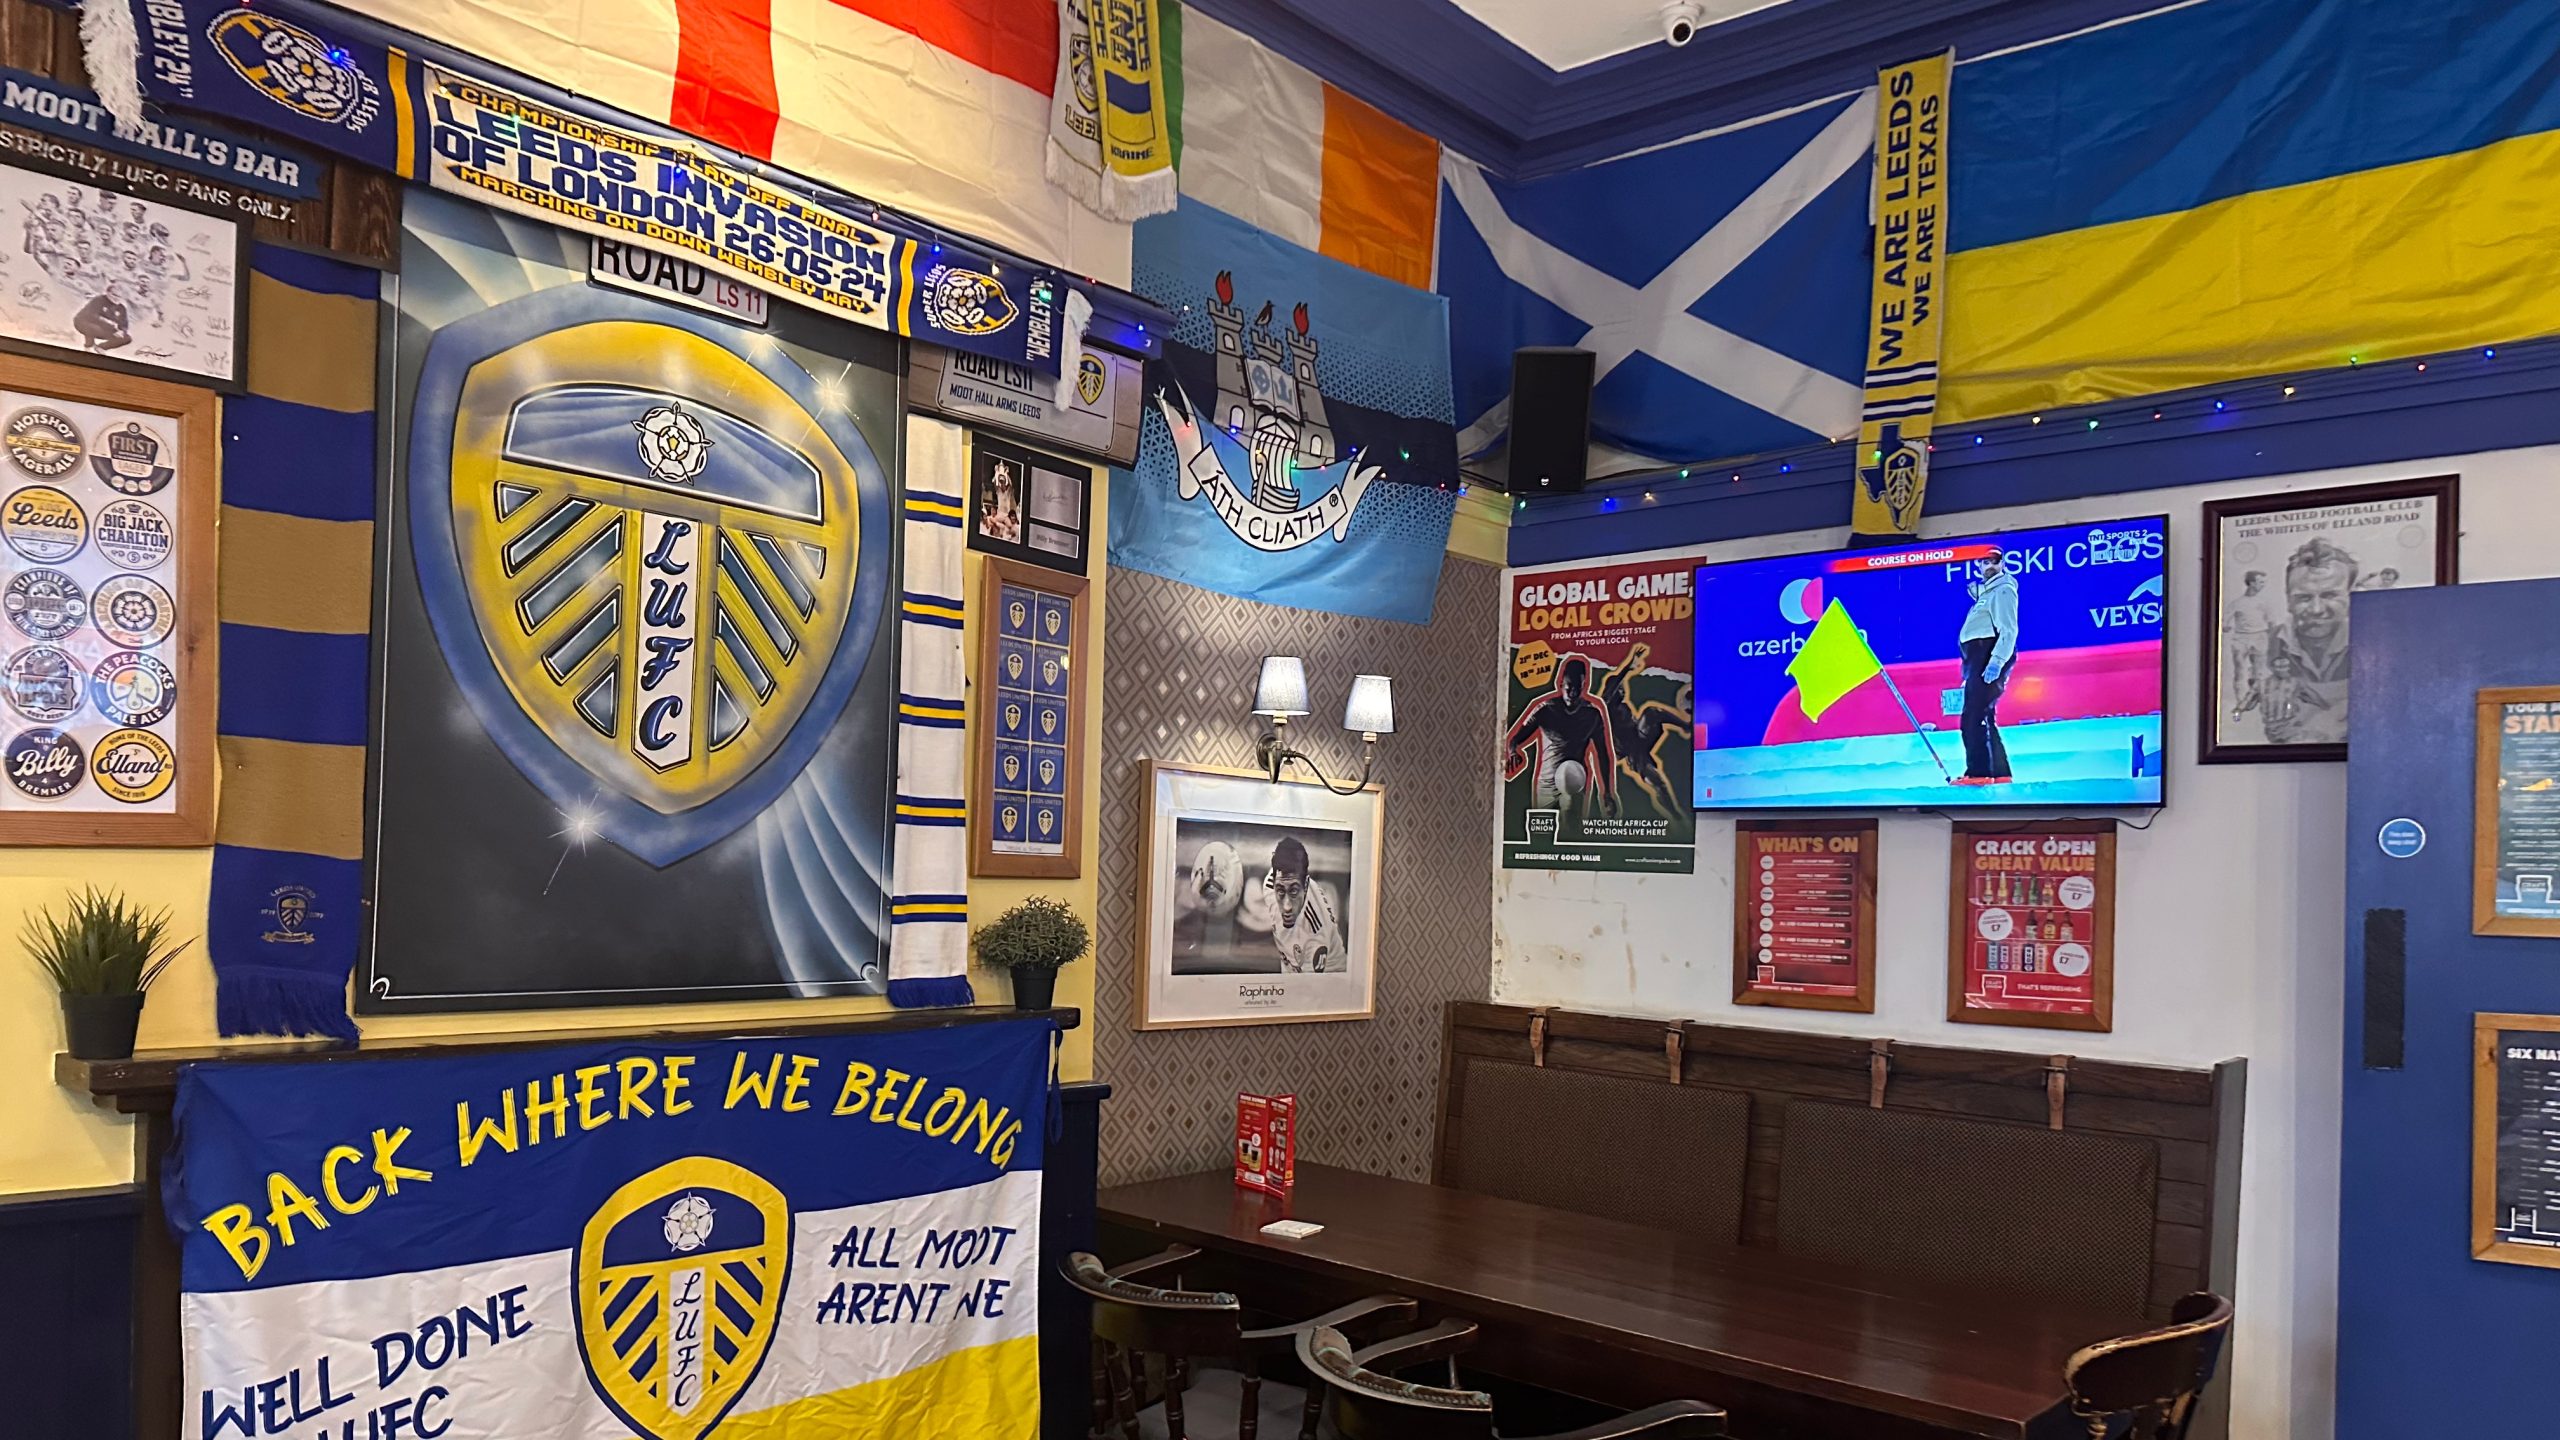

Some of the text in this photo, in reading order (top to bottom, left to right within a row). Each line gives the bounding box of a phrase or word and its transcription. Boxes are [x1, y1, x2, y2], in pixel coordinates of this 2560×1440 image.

[346, 97, 380, 133] LEEDS
[4, 81, 299, 187] MOOT BAR
[0, 131, 297, 224] STRICTLY LUFC FANS ONLY.
[460, 86, 660, 157] CHAMPIONSHIP
[746, 184, 792, 213] OFF
[801, 208, 863, 242] FINAL
[433, 93, 885, 275] LEEDS INVASION
[433, 124, 887, 303] OF LONDON 26-05-24
[1878, 70, 1914, 367] WE ARE LEEDS
[1912, 94, 1939, 327] WE ARE TEXAS
[460, 166, 867, 313] MARCHING ON DOWN WEMBLEY WAY
[597, 237, 761, 315] ROAD LS 11
[921, 291, 942, 330] SUPER
[950, 383, 1042, 420] MOOT HALL ARMS LEEDS
[13, 413, 75, 438] HOTSHOT
[111, 435, 155, 455] FIRST
[12, 447, 76, 475] LAGER ALE
[7, 502, 79, 530] Leeds
[1201, 470, 1325, 544] ÁTH CLIATH
[2235, 499, 2424, 528] LEEDS UNITED FOOTBALL CLUB
[104, 513, 164, 534] BIG JACK
[2106, 530, 2141, 540] SPORTS
[2237, 511, 2421, 539] THE WHITES OF ELLAND ROAD
[98, 527, 169, 549] CHARLTON
[1867, 550, 1954, 567] COURSE ON HOLD
[1519, 571, 1694, 608] GLOBAL GAME,
[1518, 597, 1694, 632] LOCAL CROWD
[638, 519, 694, 752] LUFC
[1551, 625, 1656, 640] FROM AFRICA'S BIGGEST STAGE
[1575, 636, 1630, 647] TO YOUR LOCAL
[1533, 650, 1550, 661] DEC
[95, 653, 175, 690] THE PEACOCKS
[1535, 665, 1552, 675] JAN
[105, 705, 164, 725] PALE ALE
[2505, 703, 2547, 713] YOUR
[33, 736, 59, 745] KING
[12, 746, 79, 778] Billy
[96, 748, 168, 775] Elland
[18, 780, 72, 796] BREMNER
[1531, 818, 1554, 826] CRAFT
[1582, 819, 1607, 827] WATCH
[1609, 819, 1623, 827] THE
[1624, 819, 1651, 827] AFRICA
[1583, 827, 1667, 836] OF NATIONS LIVE HERE
[1514, 853, 1559, 861] REFRESHINGLY
[1560, 853, 1581, 862] GOOD
[1757, 837, 1859, 853] WHAT'S ON
[1975, 840, 2097, 855] CRACK OPEN
[1975, 856, 2096, 872] GREAT VALUE
[2071, 892, 2082, 900] £7
[1991, 924, 2001, 932] £7
[2059, 956, 2069, 964] £7
[1239, 985, 1285, 1000] Raphinha
[2018, 983, 2038, 991] THAT'S
[2507, 1047, 2533, 1060] SIX
[200, 1051, 1022, 1281] BACK WHERE WE BELONG
[828, 1225, 900, 1269] ALL
[815, 1281, 950, 1325] ARENT
[673, 1271, 703, 1408] LUFC
[201, 1284, 534, 1440] WELL DONE
